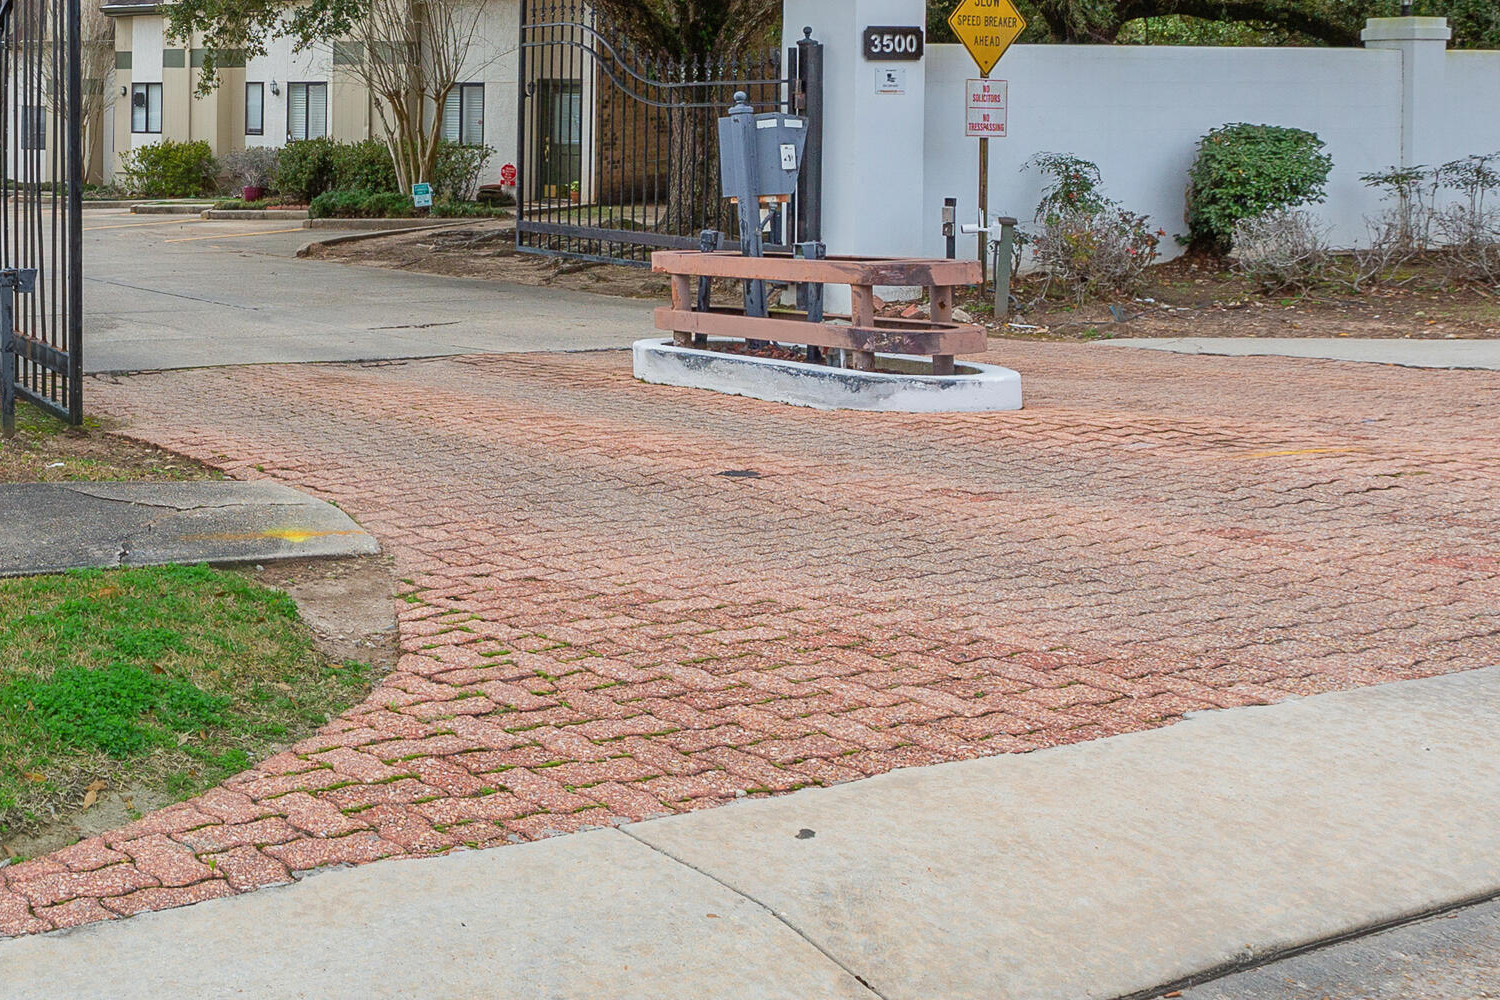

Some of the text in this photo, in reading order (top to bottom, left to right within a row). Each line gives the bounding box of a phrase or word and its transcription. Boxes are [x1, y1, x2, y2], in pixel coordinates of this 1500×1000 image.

[957, 14, 1017, 28] SPEED BREAKER
[870, 34, 917, 54] 3500
[973, 35, 1000, 47] AHEAD
[982, 85, 990, 93] NO
[972, 93, 1001, 103] SOLICITORS
[982, 113, 990, 122] NO
